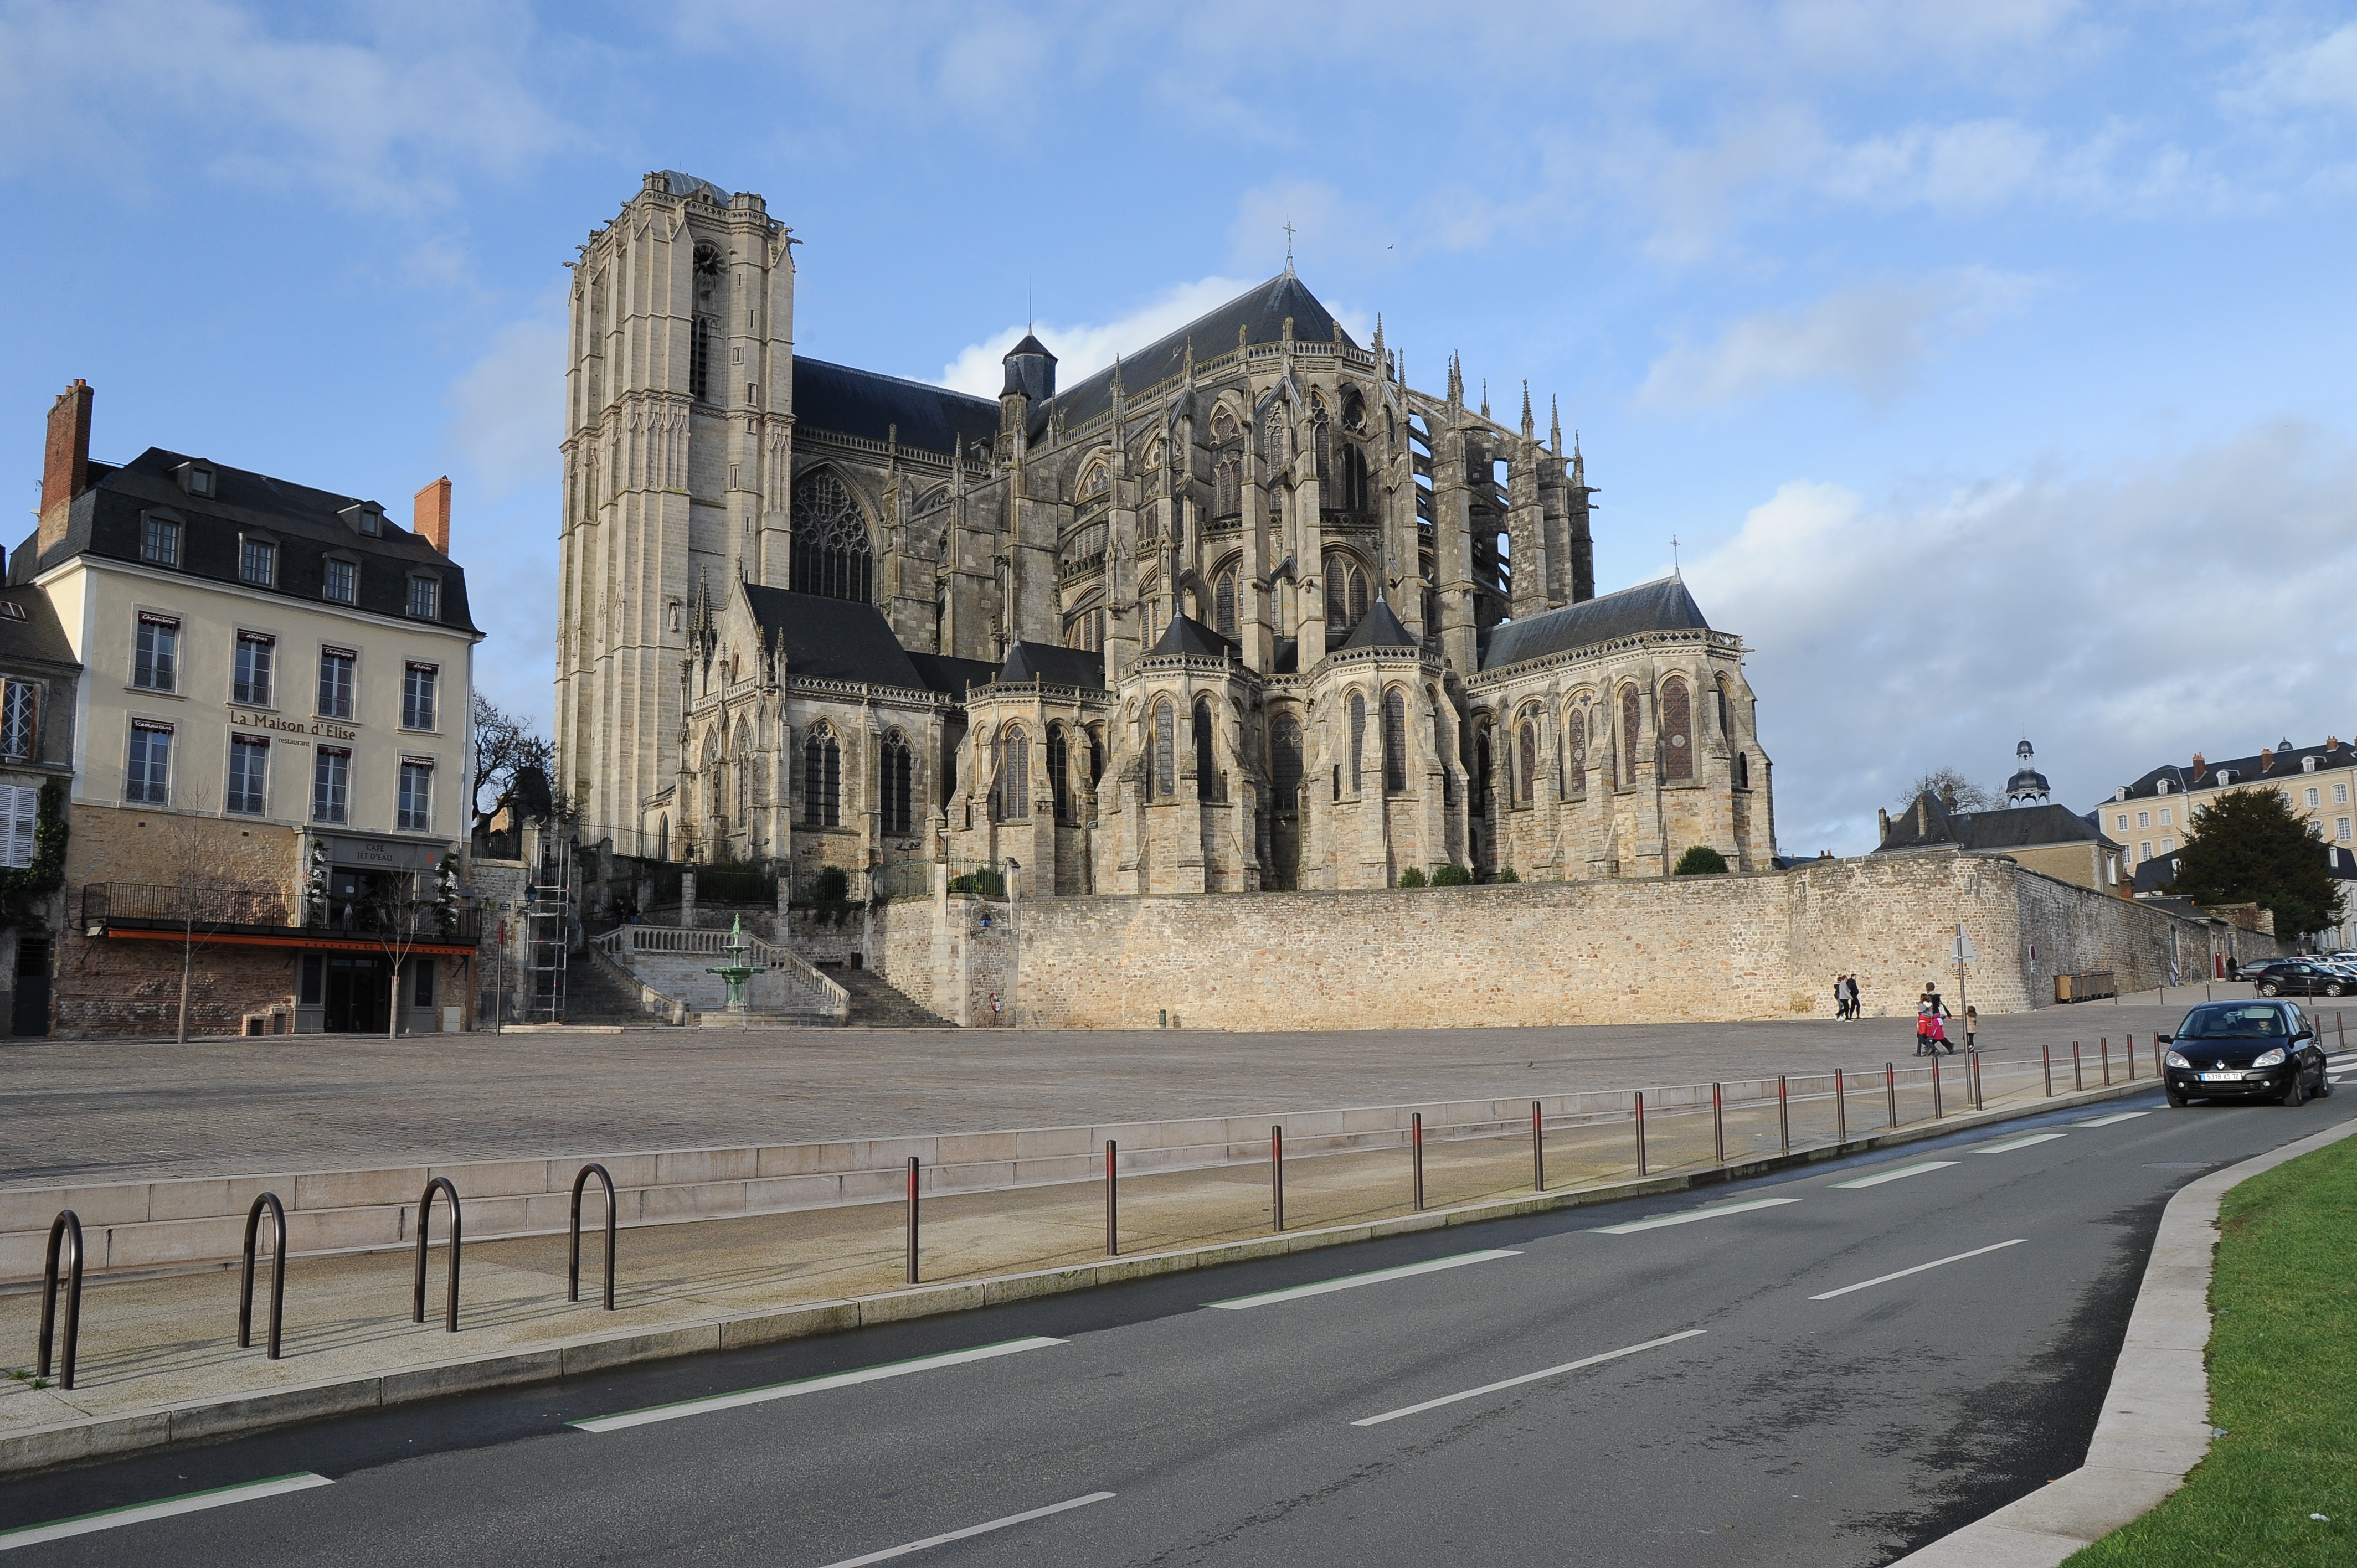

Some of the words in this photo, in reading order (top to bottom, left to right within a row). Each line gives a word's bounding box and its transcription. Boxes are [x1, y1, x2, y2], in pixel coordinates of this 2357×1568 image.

[142, 614, 176, 624] Chambres
[325, 648, 353, 657] Chambres
[134, 721, 172, 730] Restaurant
[230, 710, 246, 724] La
[254, 714, 304, 733] Maison
[311, 723, 356, 740] d'Elise
[278, 737, 310, 746] restaurant
[403, 757, 433, 765] Restaurant
